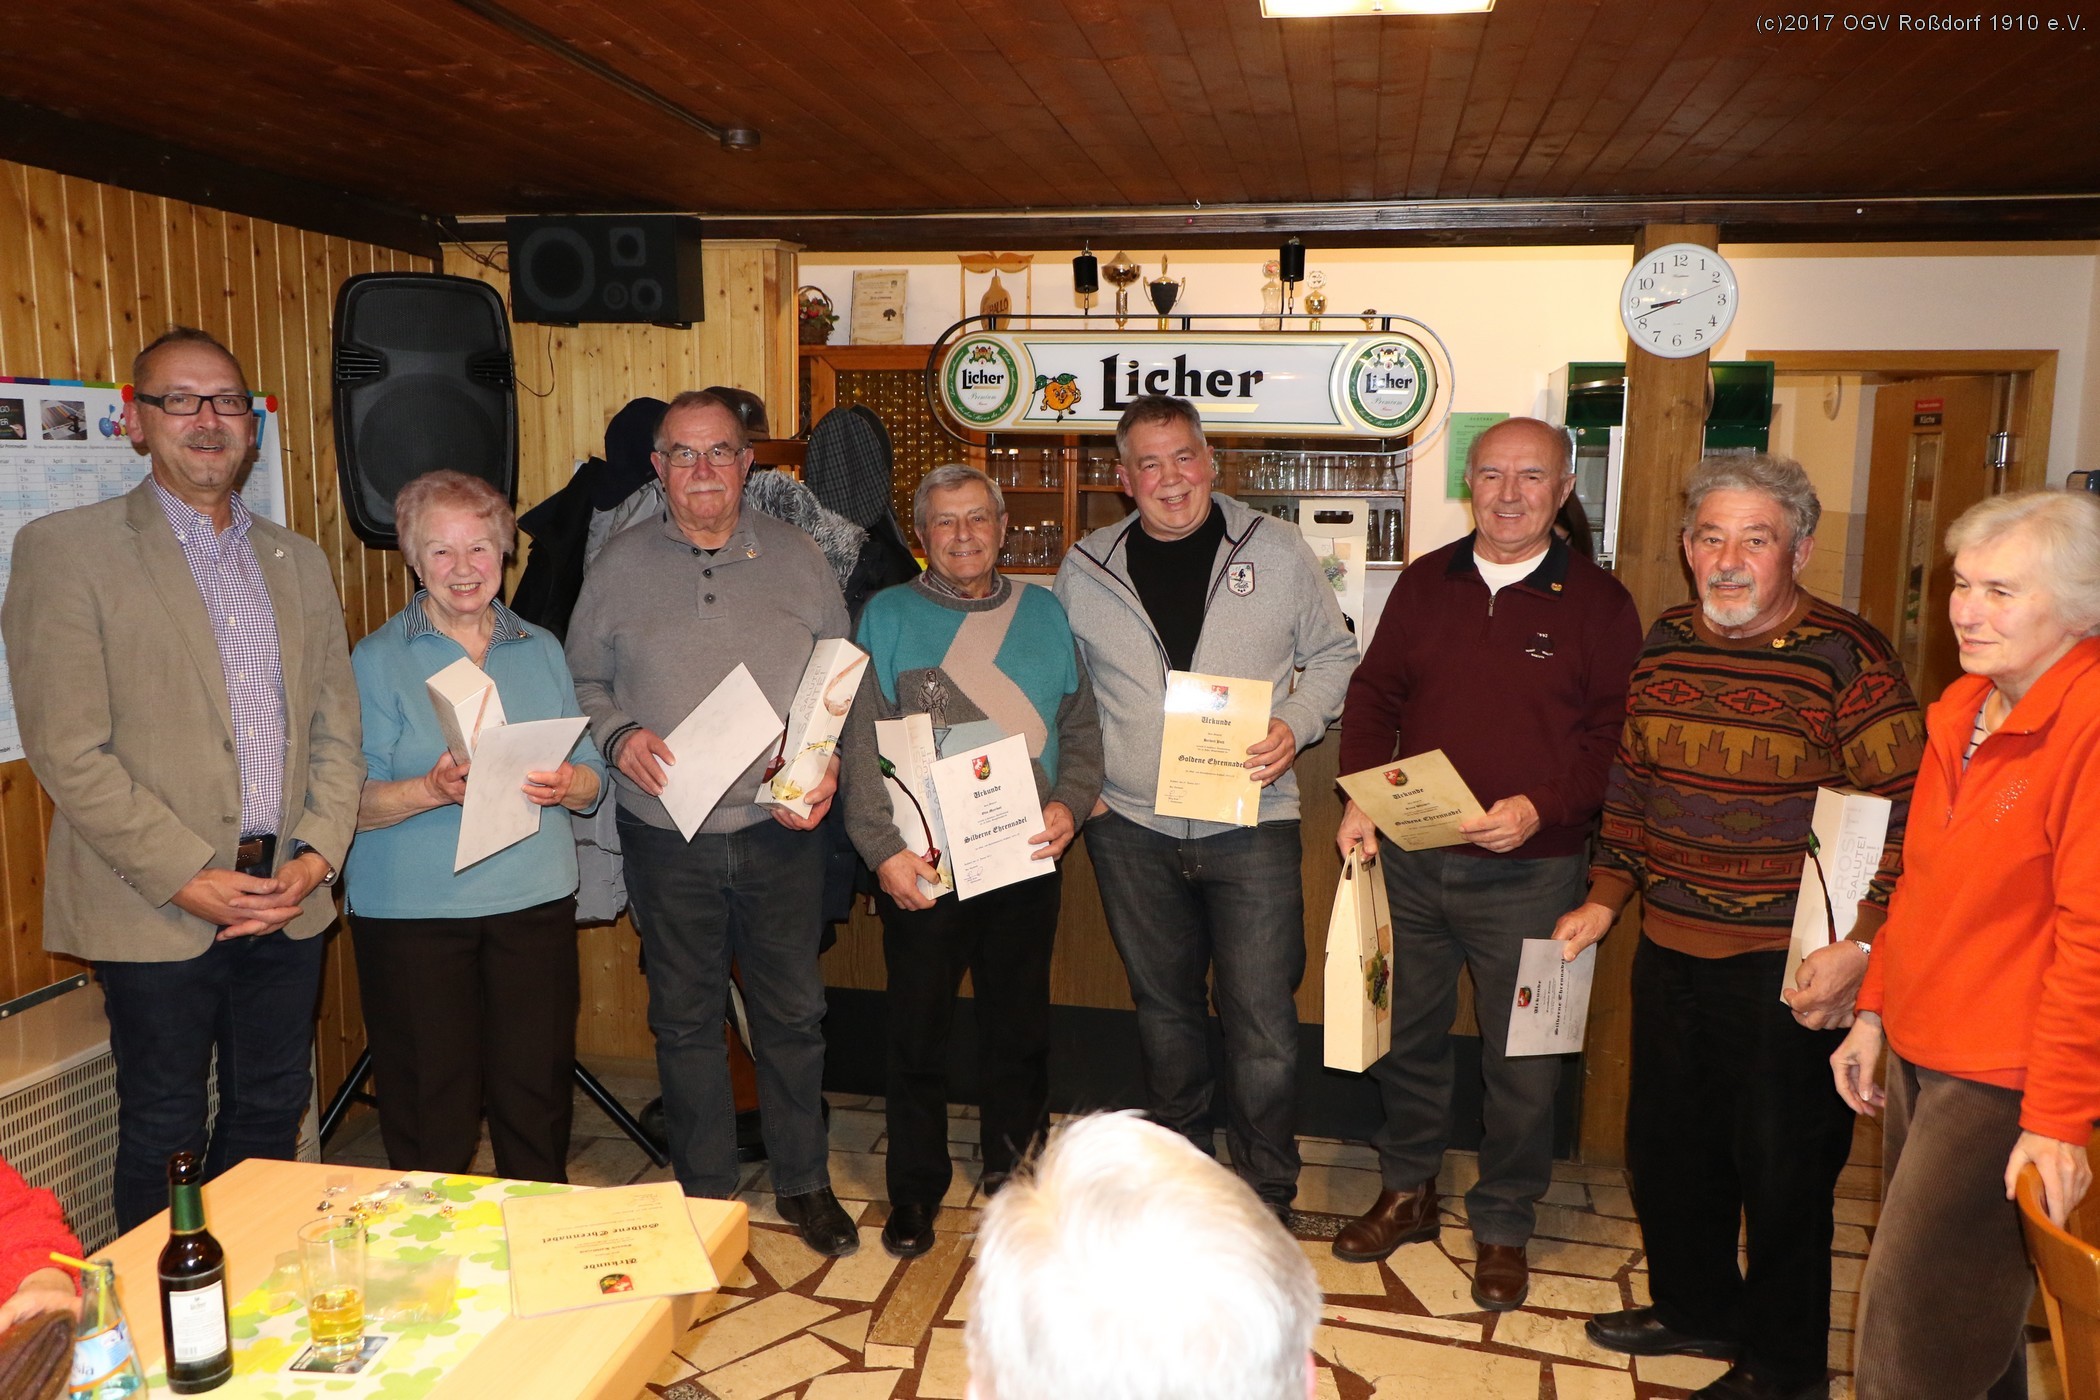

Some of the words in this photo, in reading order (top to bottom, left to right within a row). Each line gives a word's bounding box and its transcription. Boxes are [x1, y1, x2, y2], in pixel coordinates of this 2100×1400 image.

[1673, 254, 1688, 267] 12
[1700, 259, 1705, 270] 1
[1653, 262, 1664, 274] 11
[1712, 271, 1720, 283] 2
[1639, 278, 1654, 290] 10
[1631, 297, 1640, 308] 9
[1717, 294, 1726, 306] 3
[1638, 318, 1647, 329] 8
[1708, 315, 1717, 326] 4
[1653, 331, 1661, 342] 7
[1672, 335, 1681, 346] 6
[1694, 329, 1703, 340] 5
[962, 368, 1004, 389] Licher
[1099, 353, 1264, 411] Licher
[1366, 372, 1412, 393] Licher
[1201, 716, 1231, 726] Urkunde
[1178, 754, 1205, 764] Goldene
[973, 785, 1001, 799] Urkunde
[1392, 788, 1424, 800] Urkunde
[1395, 818, 1421, 826] Goldene
[1423, 808, 1462, 821] Ehrennadel
[964, 830, 991, 844] Silberne
[992, 816, 1027, 833] Ehrennadel
[1846, 836, 1867, 899] SALUTE!
[611, 1222, 659, 1235] Goldene
[542, 1230, 609, 1244] Ehrennadel
[584, 1257, 637, 1271] Urkunde
